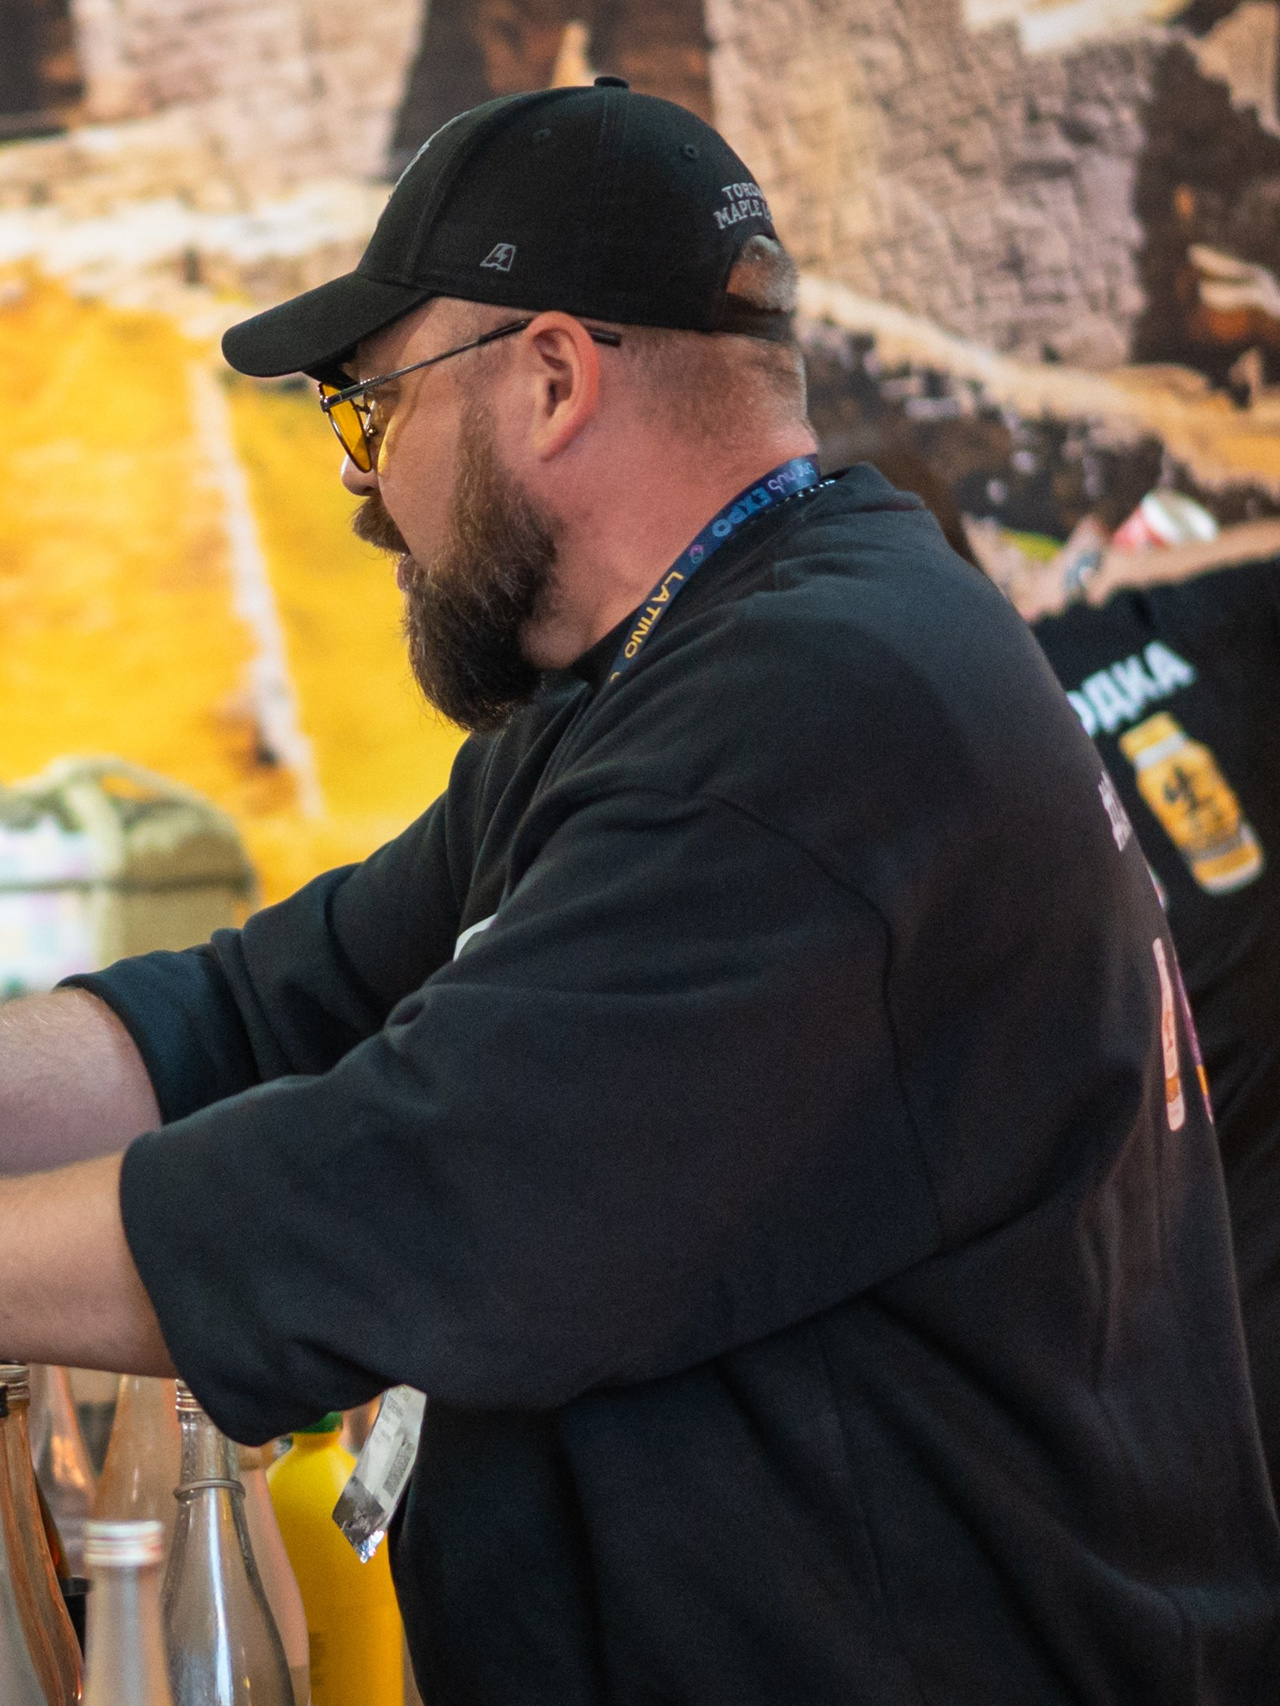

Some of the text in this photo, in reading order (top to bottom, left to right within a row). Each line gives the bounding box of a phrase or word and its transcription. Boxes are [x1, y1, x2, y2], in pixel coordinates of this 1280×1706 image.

[713, 199, 762, 229] MAPLE
[712, 485, 771, 537] EXPO
[624, 571, 684, 659] LATINO
